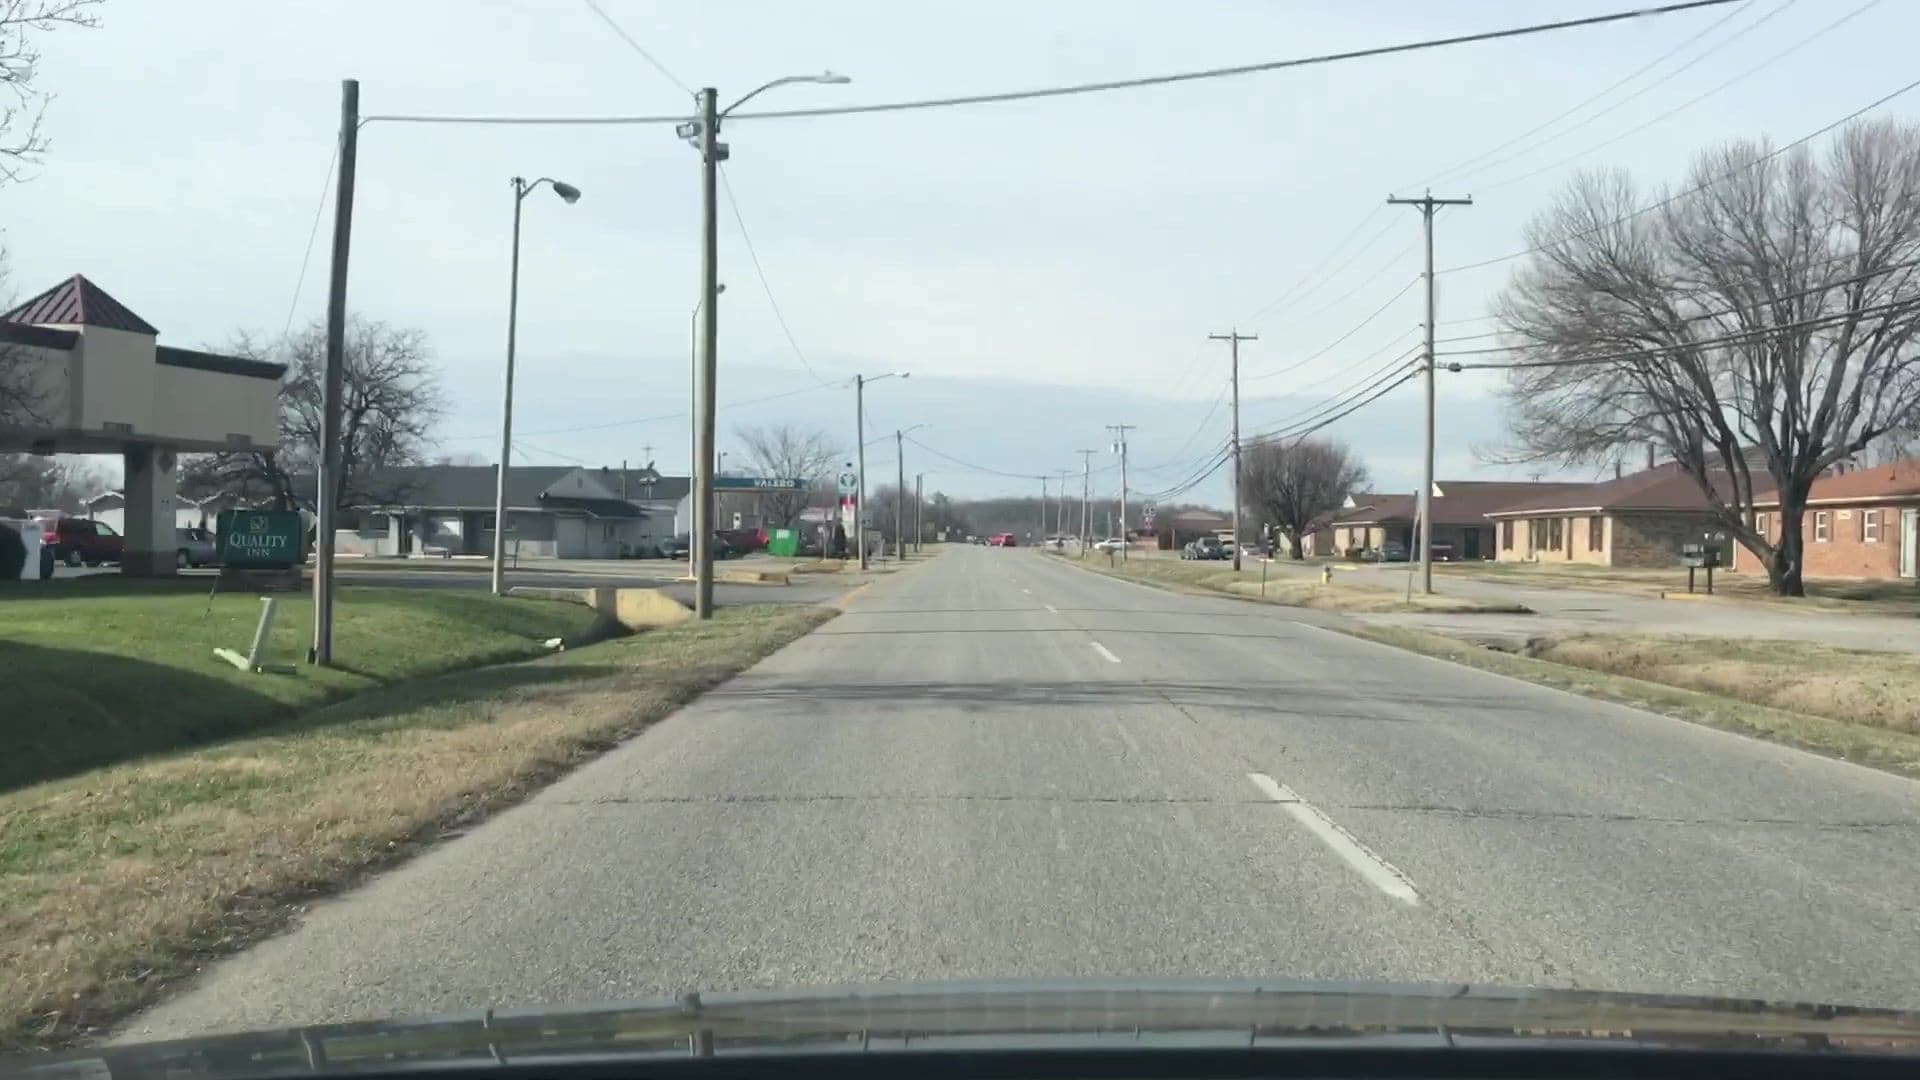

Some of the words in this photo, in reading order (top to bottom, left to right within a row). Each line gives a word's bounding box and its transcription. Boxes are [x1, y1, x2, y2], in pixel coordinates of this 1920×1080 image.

[754, 480, 795, 488] VALERO
[230, 532, 287, 548] QUALITY
[247, 548, 270, 557] INN
